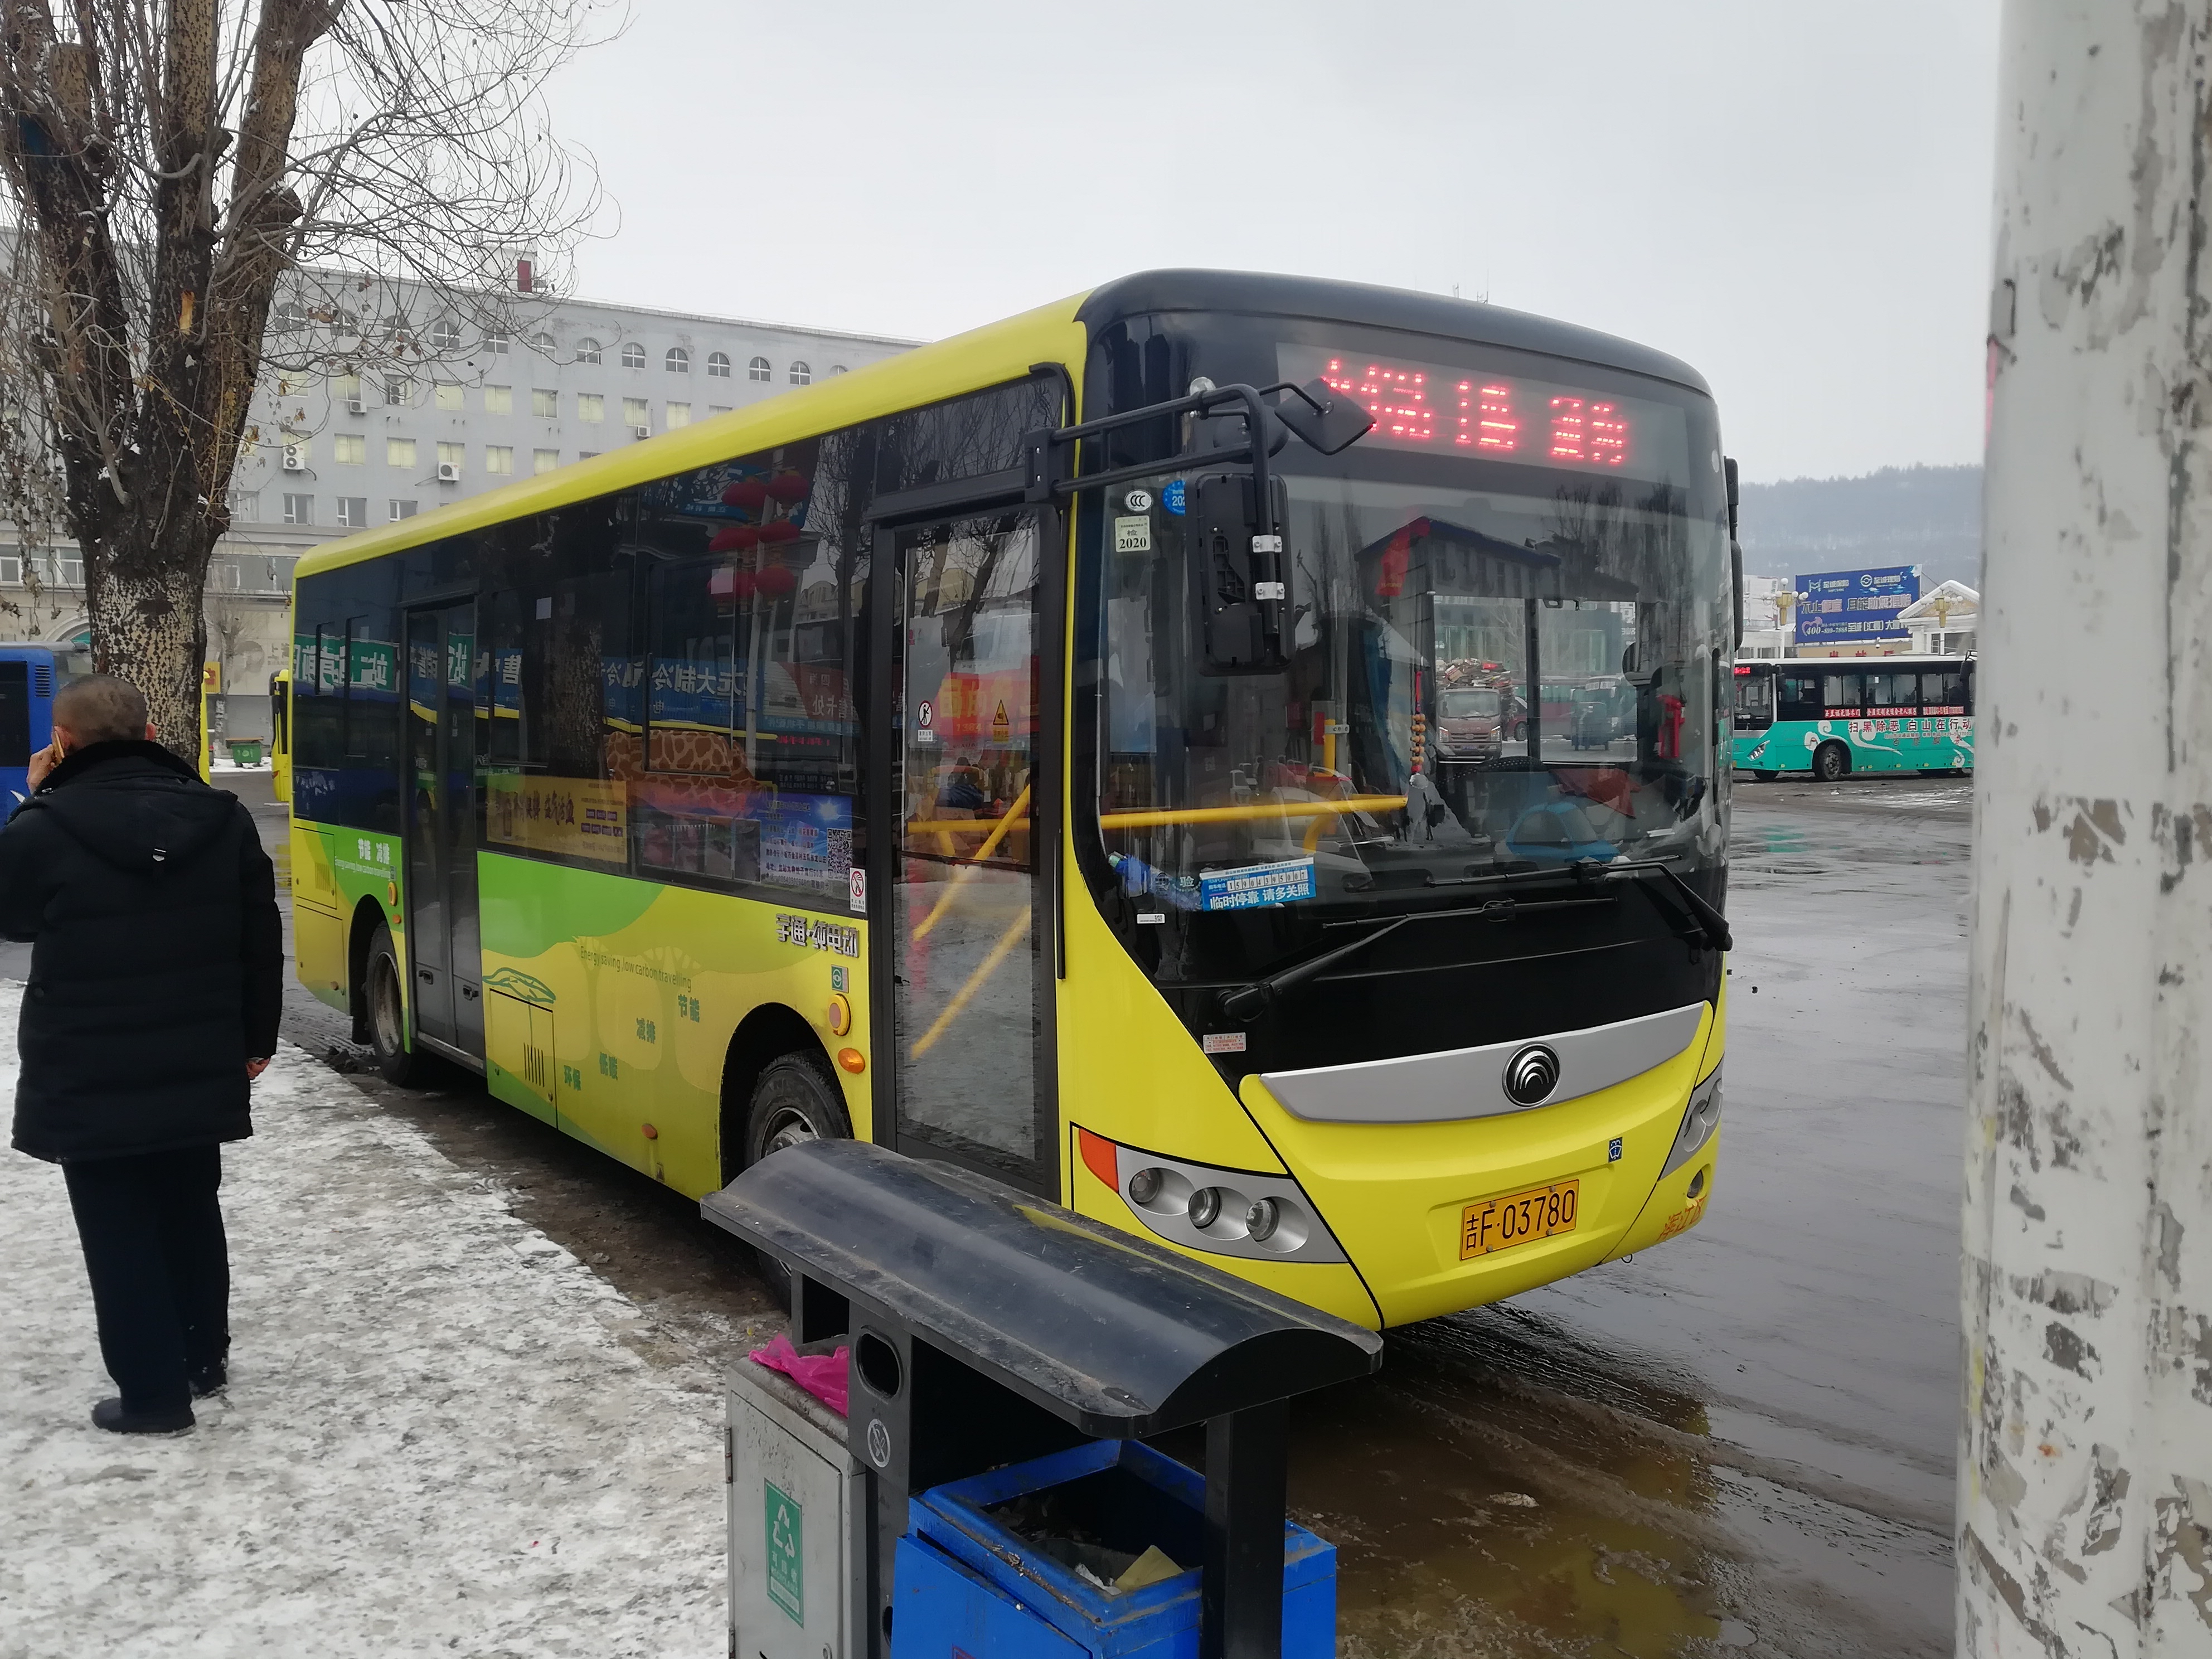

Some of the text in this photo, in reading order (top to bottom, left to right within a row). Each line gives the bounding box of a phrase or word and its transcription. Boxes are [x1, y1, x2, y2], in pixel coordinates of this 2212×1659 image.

[1119, 537, 1147, 550] 2020
[1849, 718, 1973, 733] 扫黑除恶 白山在行动
[1180, 875, 1195, 887] 验
[1229, 871, 1306, 890] 15904395007
[1210, 882, 1310, 910] 临时停靠 请多关照
[580, 945, 600, 967] Energy
[601, 954, 620, 973] saving
[635, 963, 658, 980] carbon
[658, 969, 692, 993] travelling
[677, 993, 701, 1023] 节能
[636, 1017, 656, 1045] 减排
[564, 1064, 582, 1091] 环保
[599, 1051, 618, 1081] 低碳
